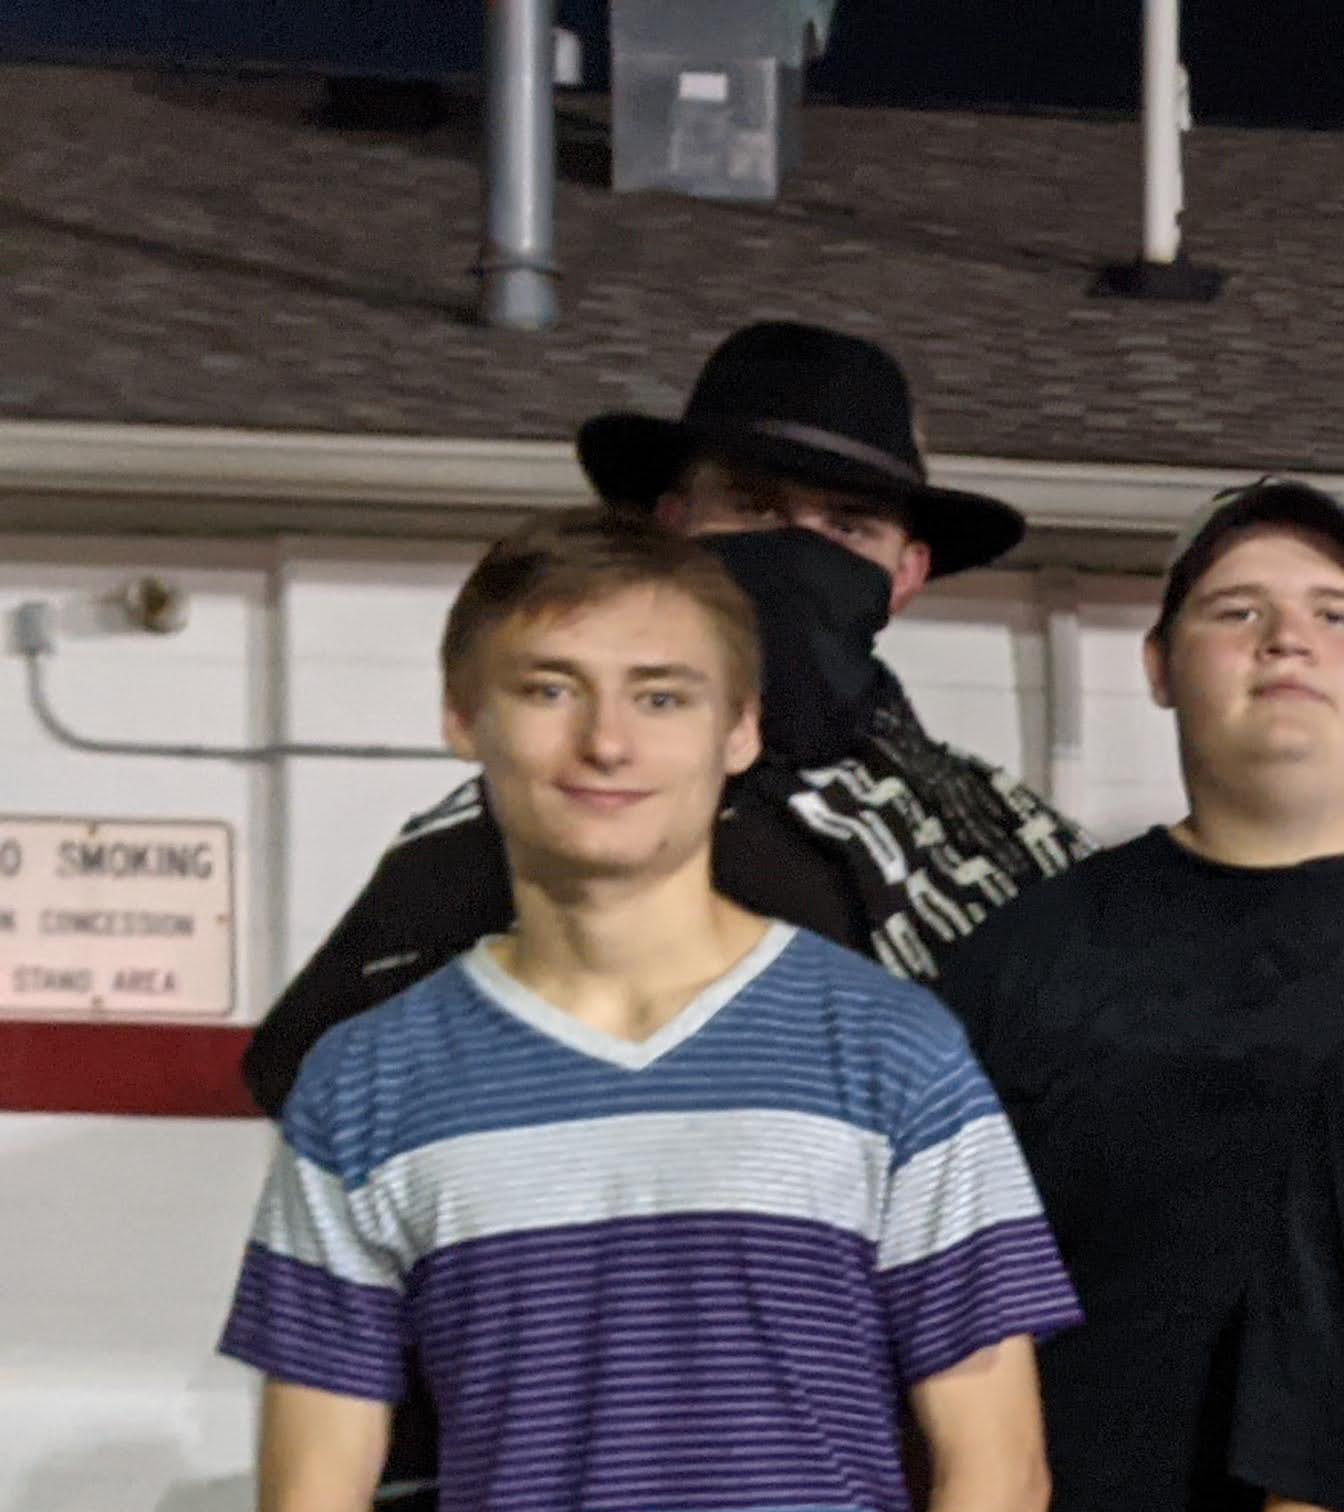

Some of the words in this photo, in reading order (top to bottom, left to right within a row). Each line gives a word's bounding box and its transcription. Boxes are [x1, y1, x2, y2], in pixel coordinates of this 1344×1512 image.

[0, 837, 22, 877] O
[57, 839, 213, 879] SMOKING
[13, 964, 93, 994] STAND
[112, 967, 176, 994] AREA
